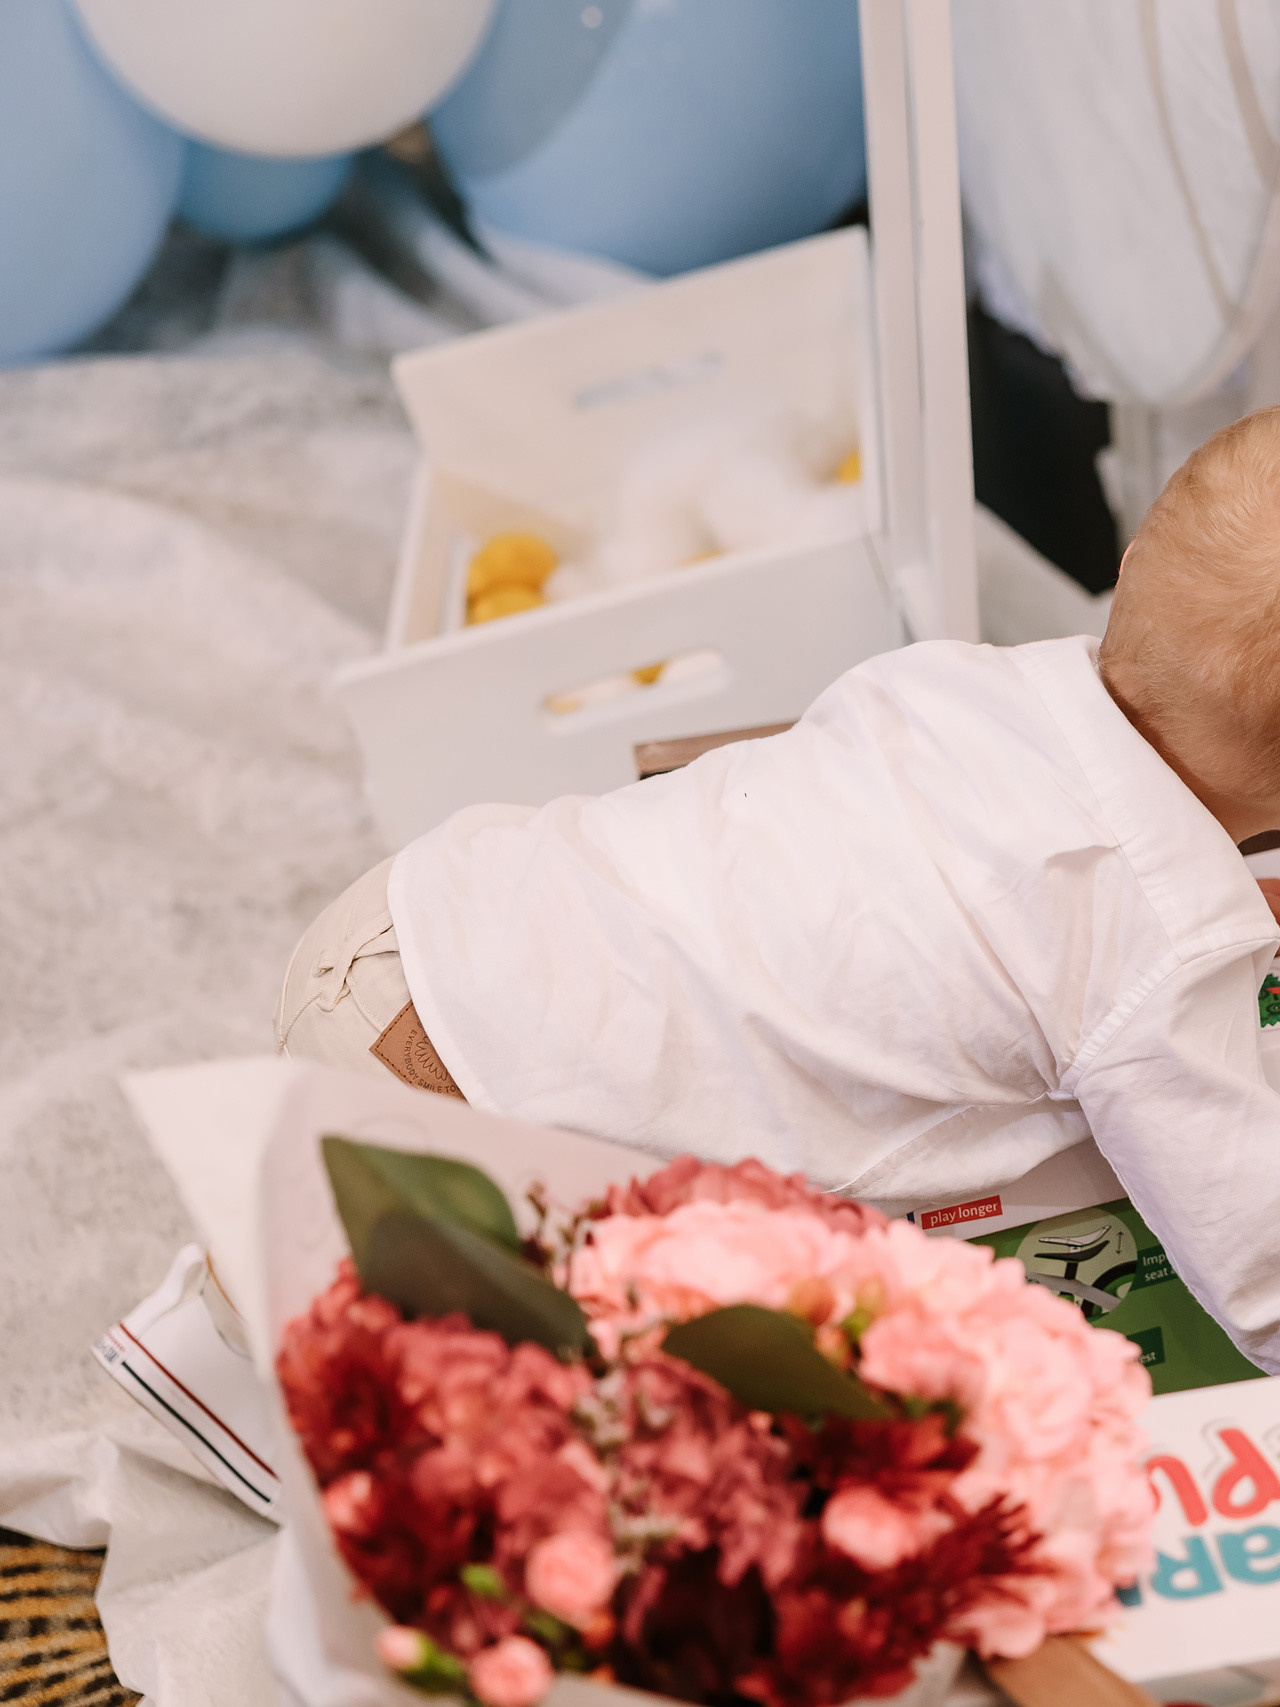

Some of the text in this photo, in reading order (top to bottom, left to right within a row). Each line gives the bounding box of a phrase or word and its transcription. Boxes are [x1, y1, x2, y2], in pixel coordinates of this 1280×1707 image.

[404, 1029, 457, 1094] EVERYBODY SMILE TO
[930, 1201, 998, 1227] play longer
[1143, 1253, 1166, 1266] Imp
[1144, 1268, 1168, 1281] seat
[1139, 1351, 1156, 1363] est
